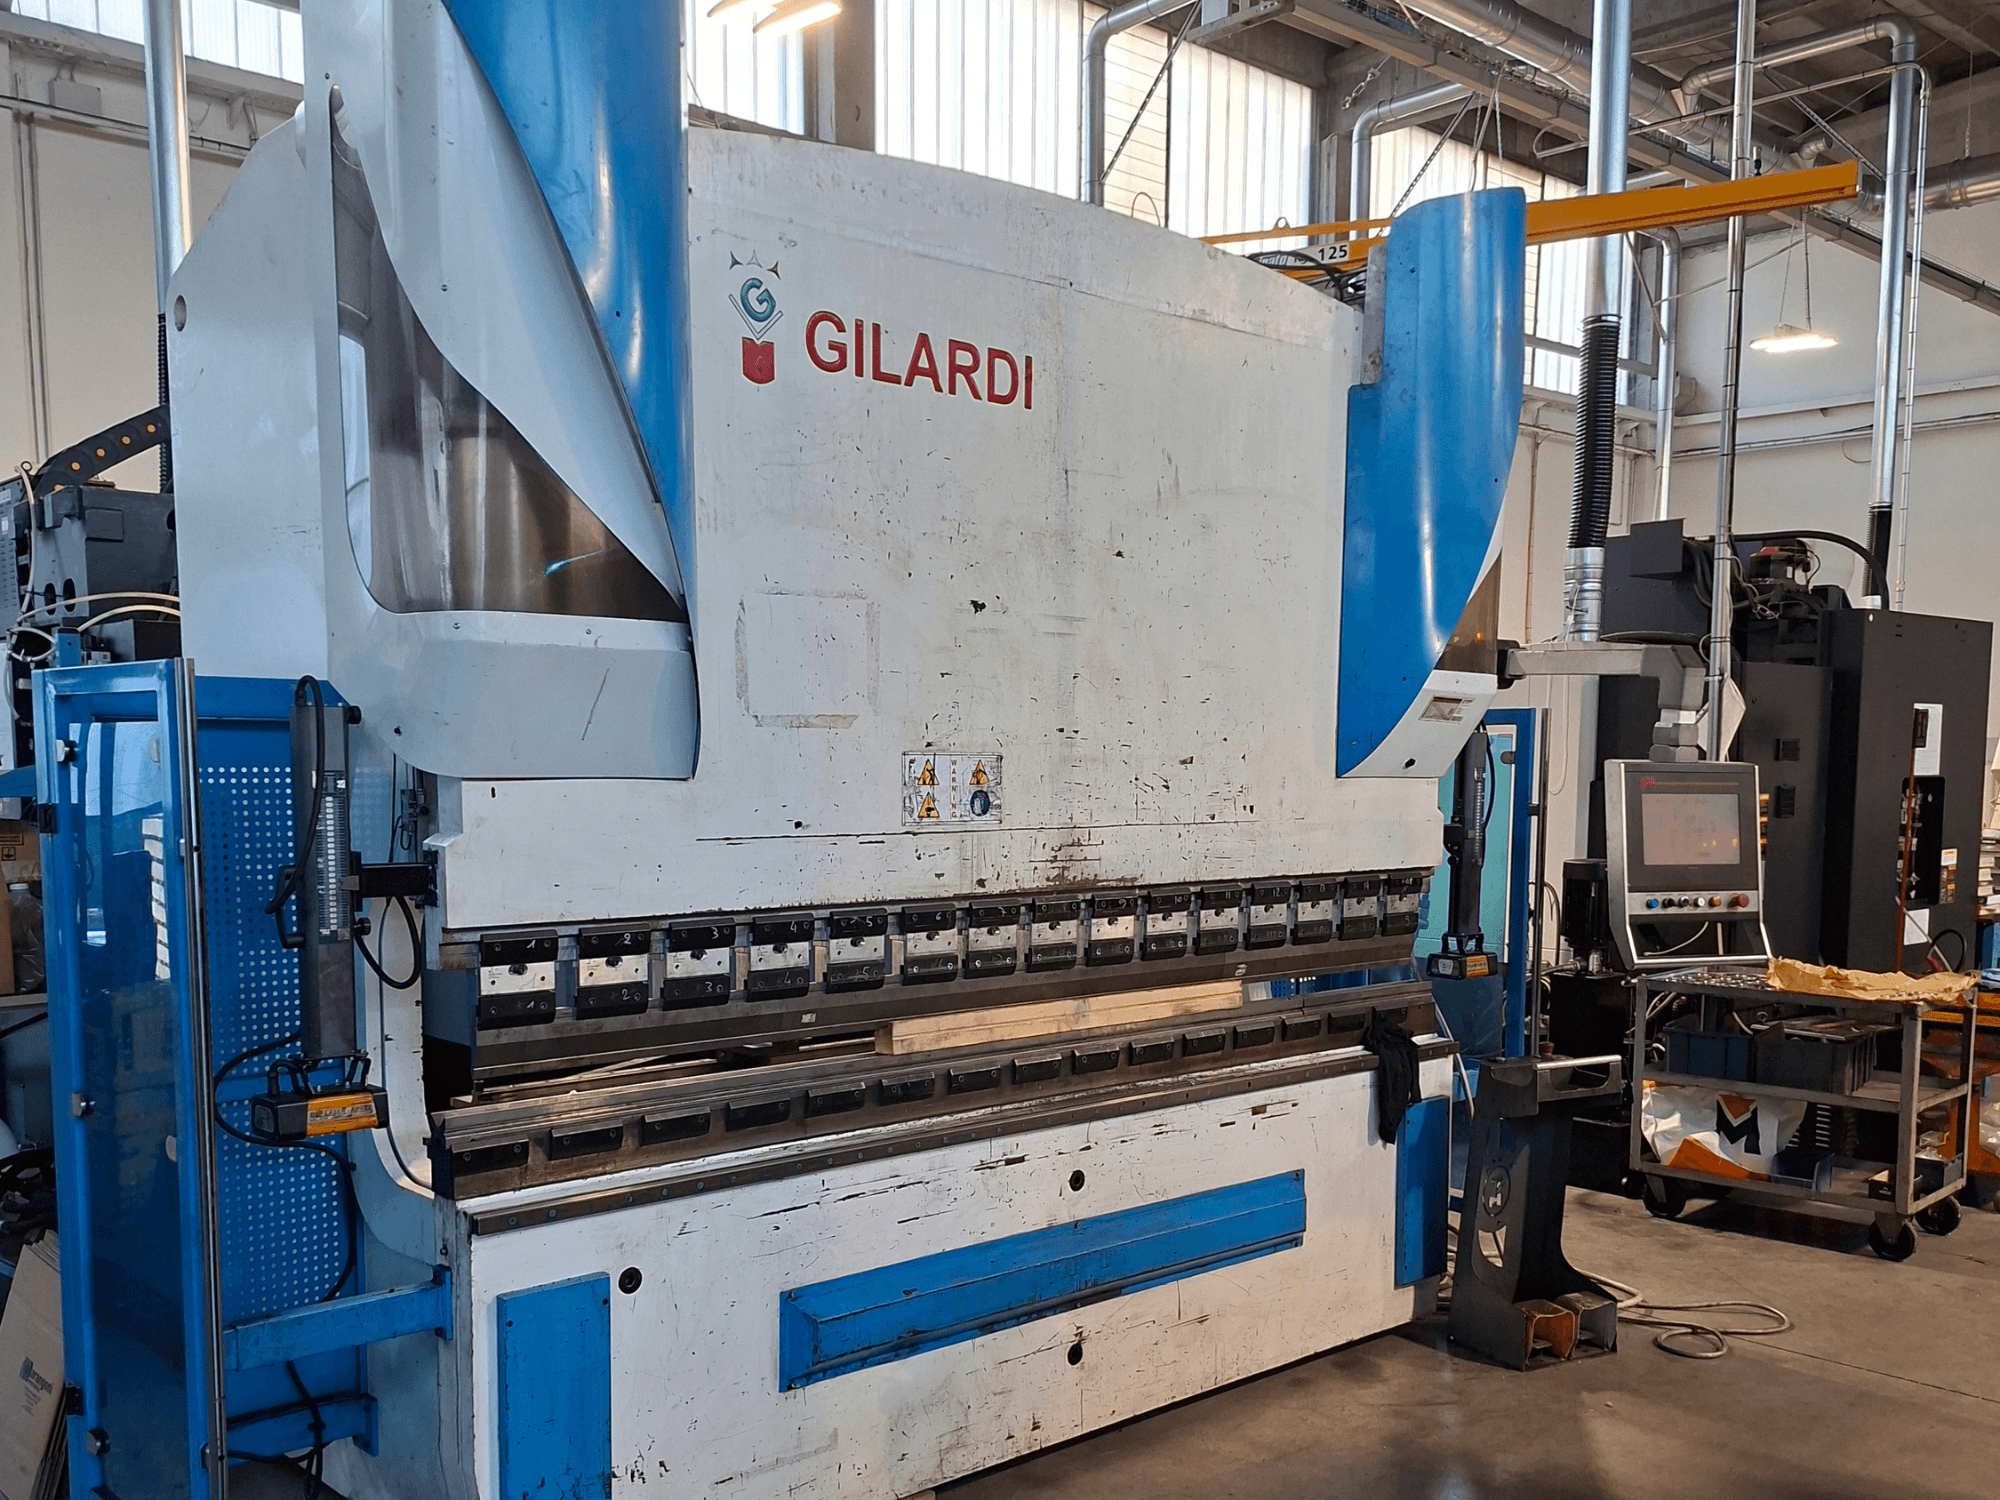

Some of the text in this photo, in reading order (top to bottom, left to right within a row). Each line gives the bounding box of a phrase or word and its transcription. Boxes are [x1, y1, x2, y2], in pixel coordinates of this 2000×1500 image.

[1318, 244, 1348, 261] 125
[740, 277, 776, 323] G
[805, 310, 1033, 410] GILARDI
[950, 759, 958, 818] WARNING
[865, 915, 874, 928] 5
[935, 911, 942, 920] 6
[789, 919, 797, 933] 4
[623, 932, 632, 945] 2
[710, 926, 719, 940] 3
[526, 939, 537, 949] 1
[704, 981, 713, 993] 3
[621, 988, 631, 1000] 2
[526, 1000, 536, 1009] 1
[1716, 1098, 1762, 1156] M
